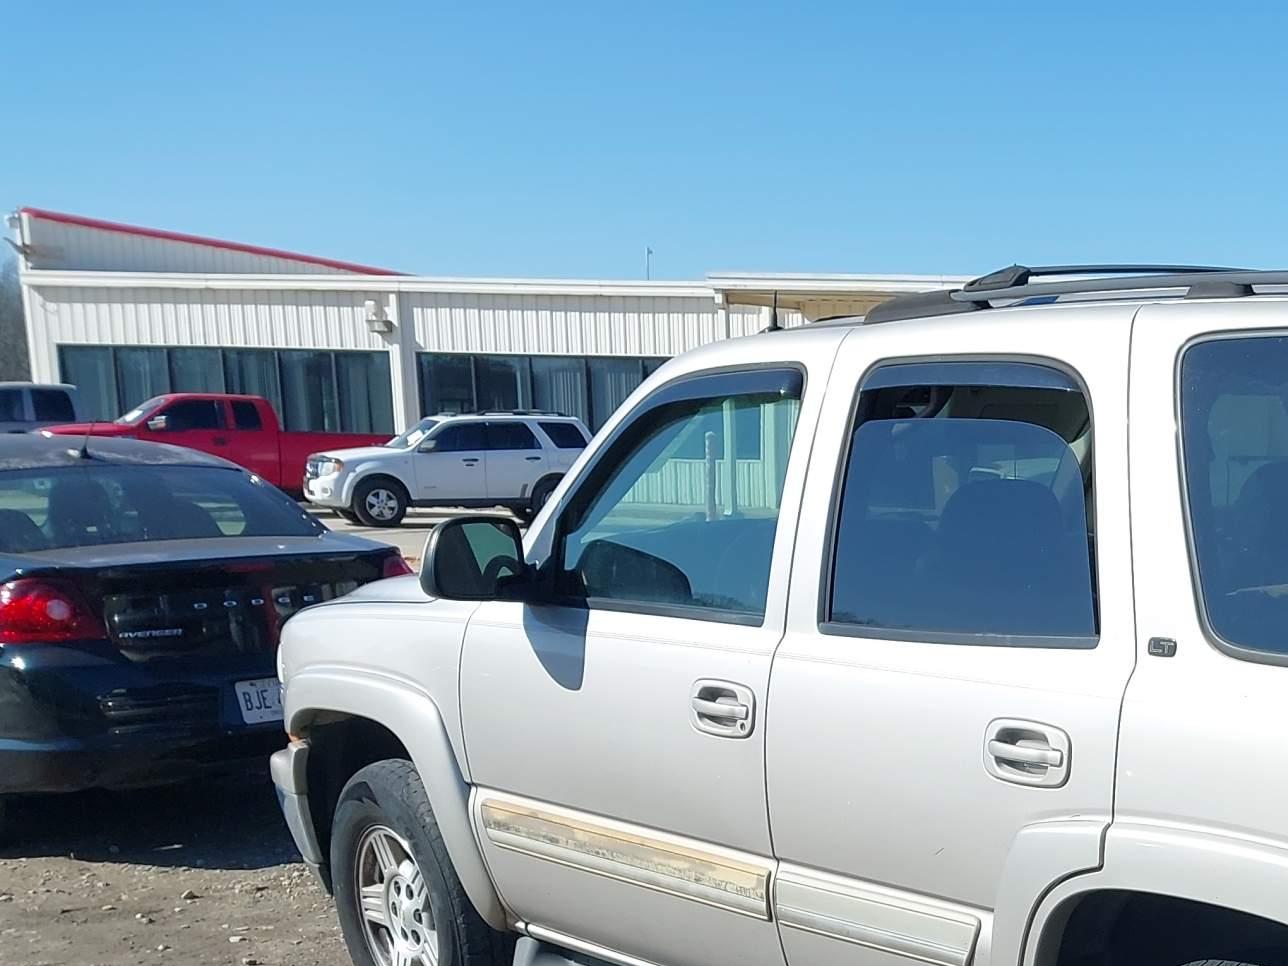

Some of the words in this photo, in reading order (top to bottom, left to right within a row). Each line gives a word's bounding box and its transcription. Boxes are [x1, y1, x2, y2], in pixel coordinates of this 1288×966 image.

[193, 594, 315, 610] DODGE
[118, 628, 183, 639] AVENGER
[1149, 639, 1175, 655] LT
[242, 689, 273, 711] BJE
